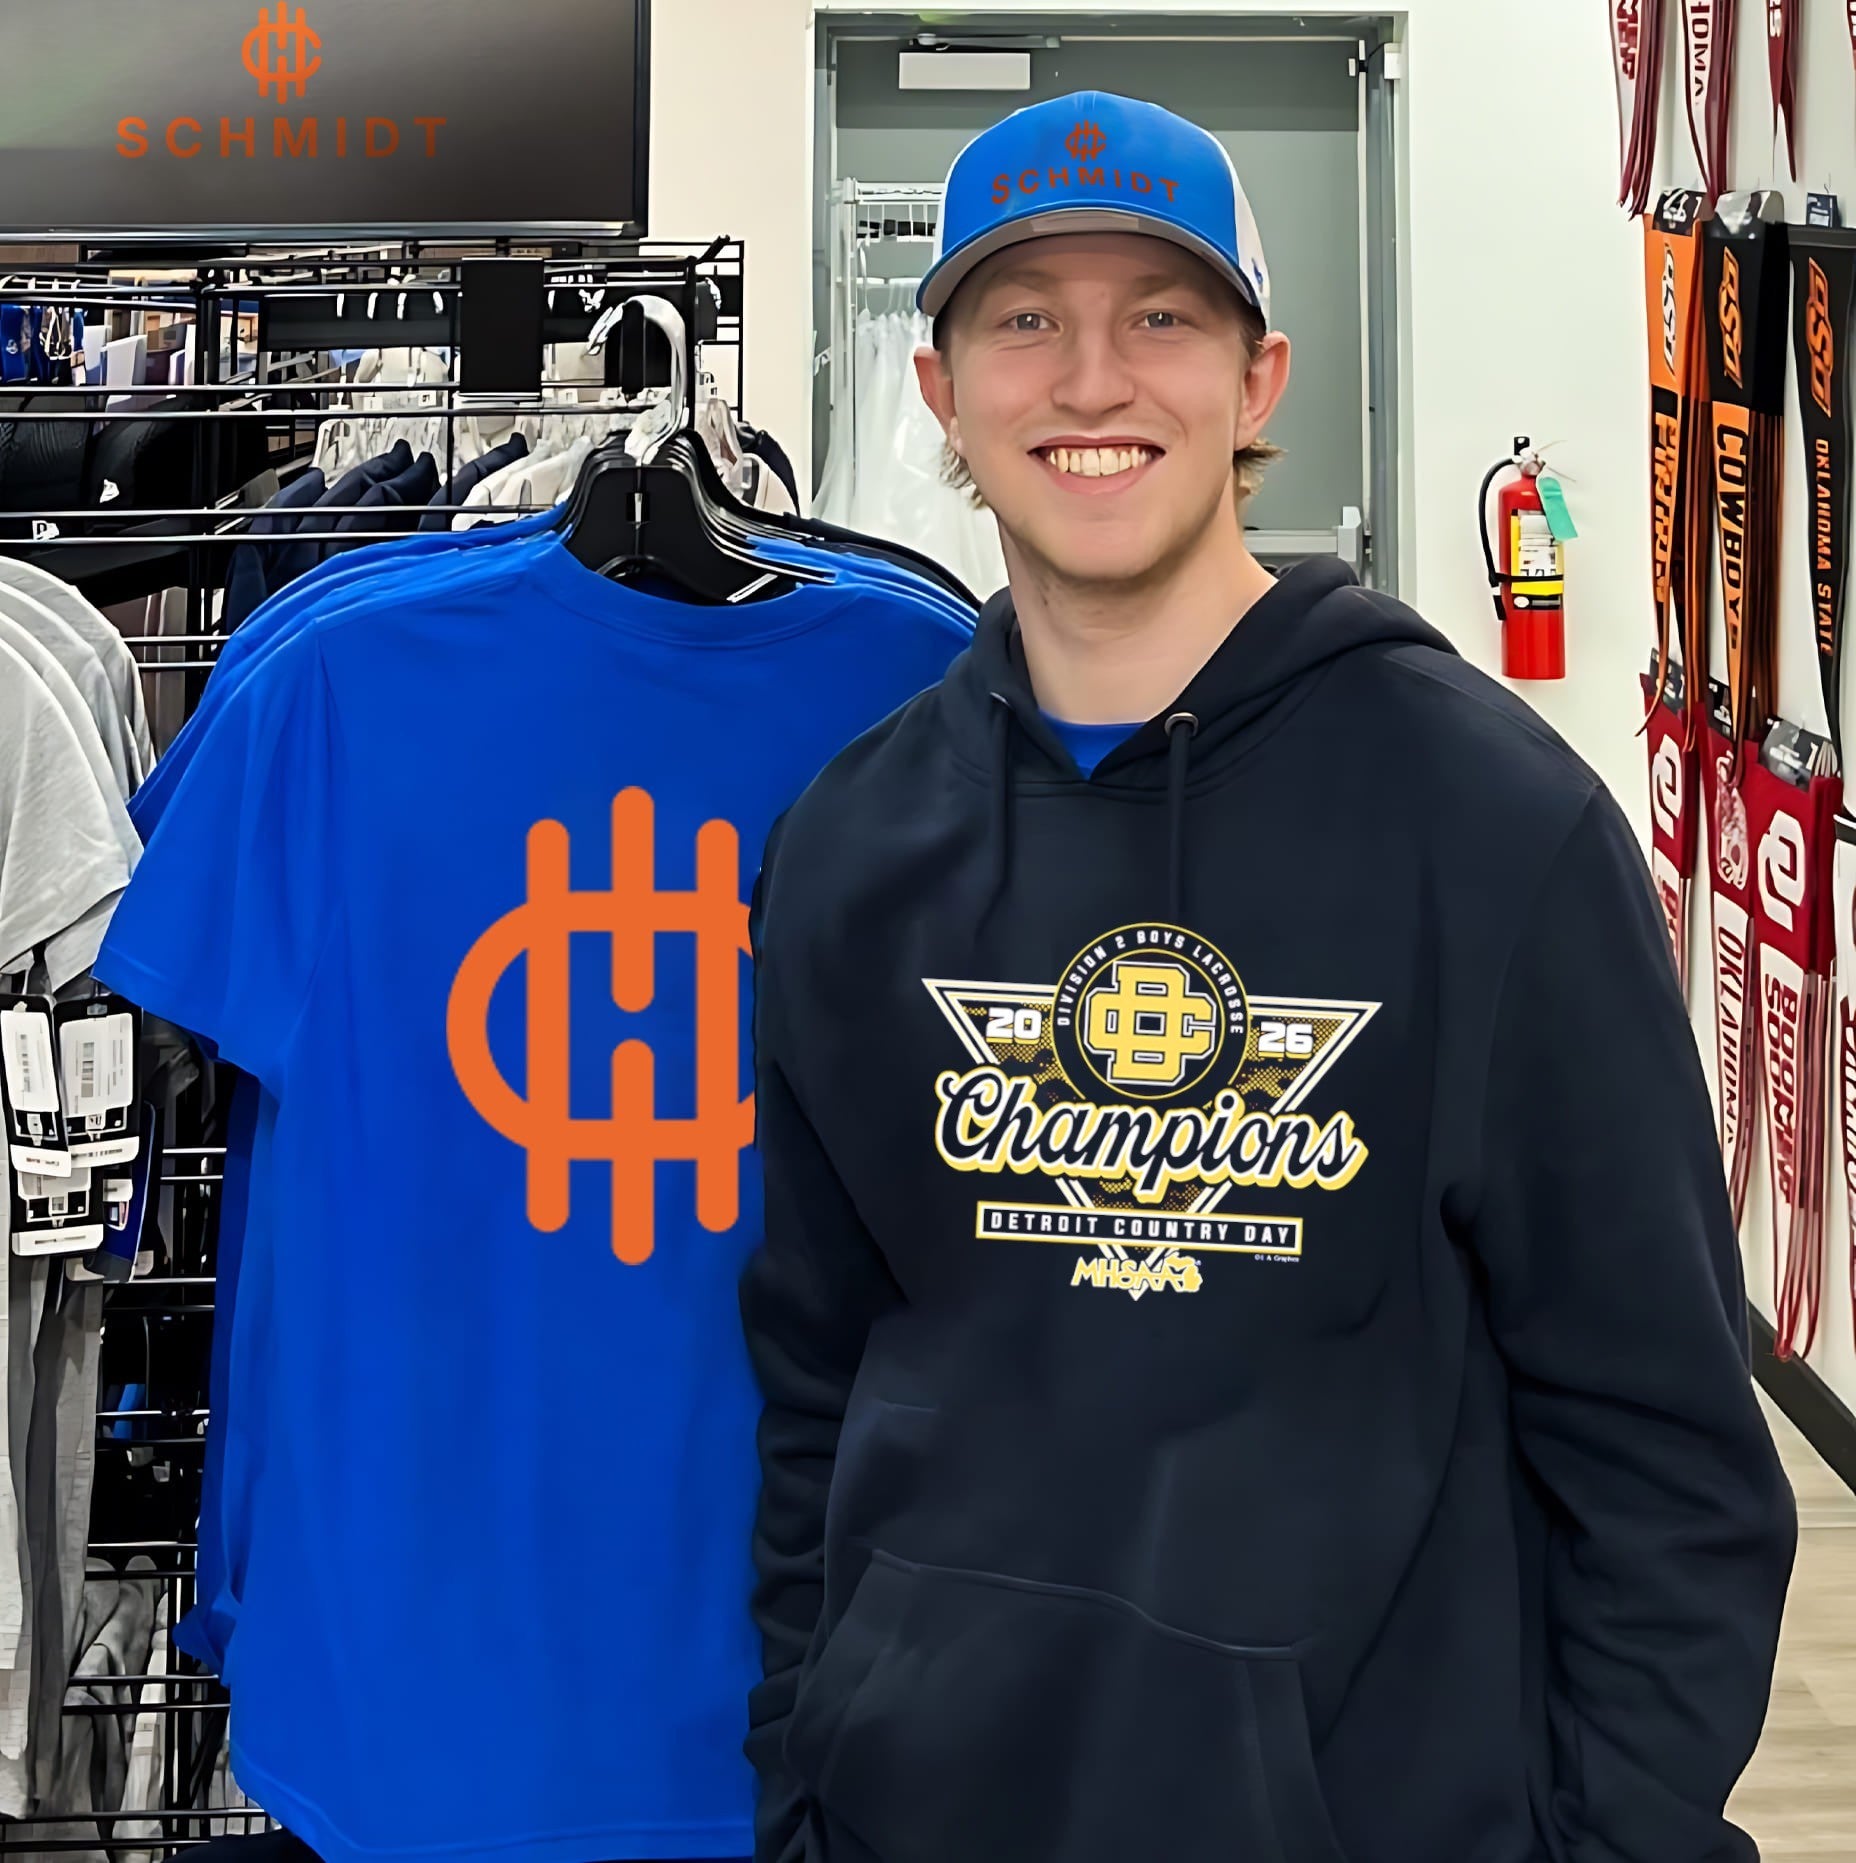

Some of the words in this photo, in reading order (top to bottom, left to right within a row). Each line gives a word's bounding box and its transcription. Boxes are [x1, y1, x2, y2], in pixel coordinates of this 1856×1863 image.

[115, 116, 447, 159] SCHMIDT
[991, 166, 1180, 204] SCHMIDT
[1057, 945, 1107, 1026] DIVISION
[1115, 935, 1126, 949] 2
[1136, 930, 1186, 949] BOYS
[1192, 945, 1245, 1034] LACROSSE
[986, 1006, 1042, 1043] 20
[1258, 1020, 1314, 1058] 26
[935, 1066, 1369, 1203] Champions
[990, 1211, 1098, 1235] DETROIT
[1114, 1218, 1228, 1241] COUNTRY
[1244, 1225, 1289, 1245] DAY
